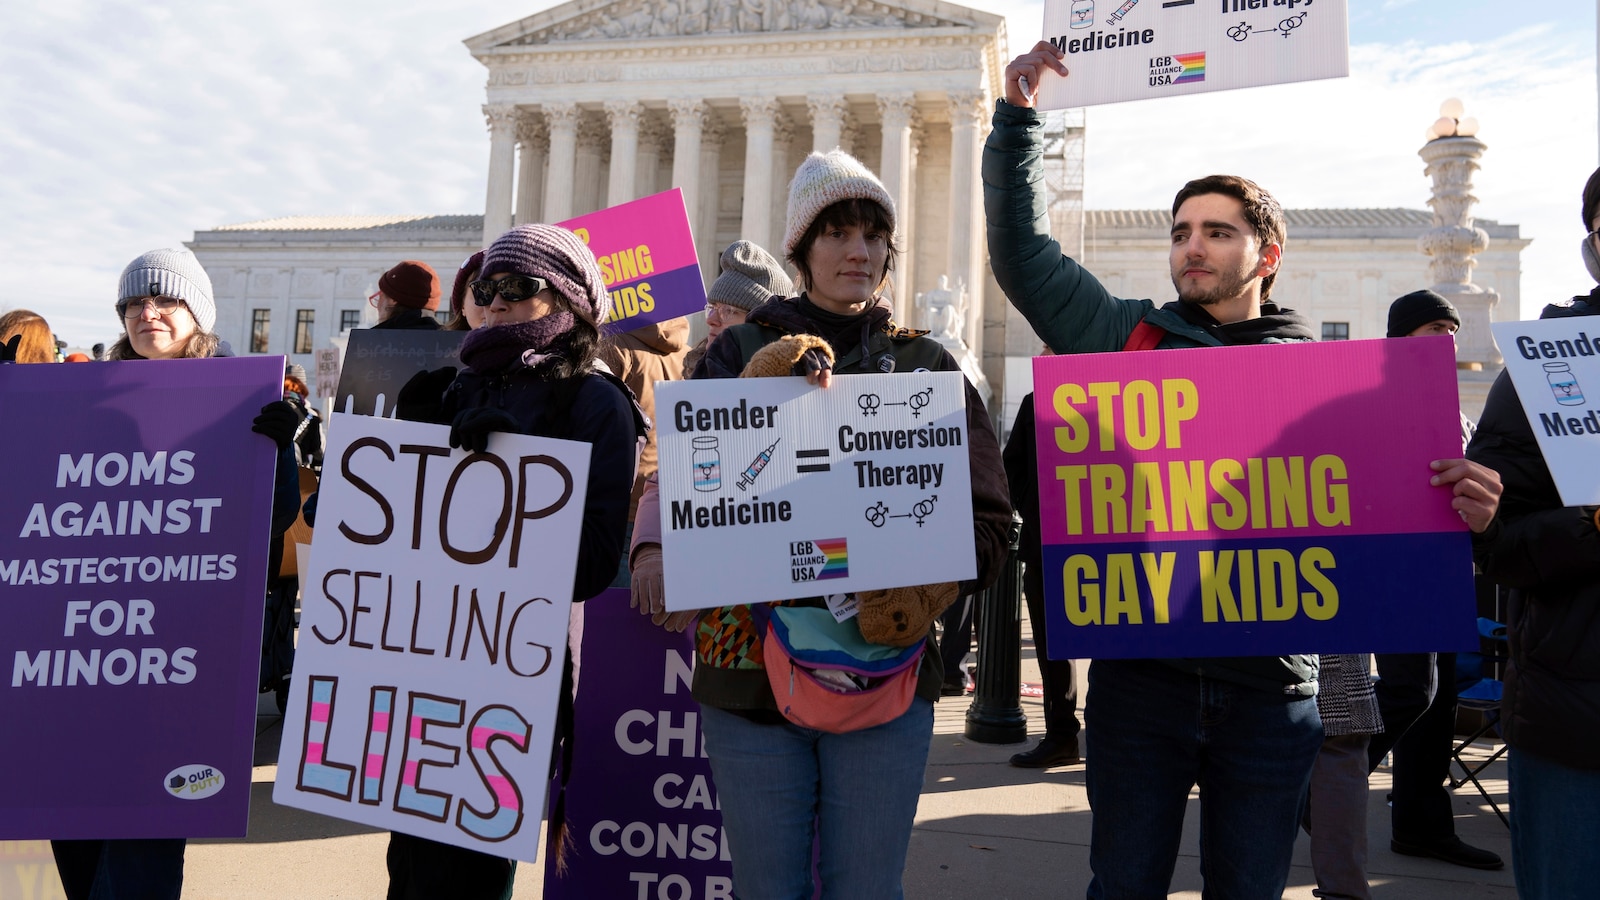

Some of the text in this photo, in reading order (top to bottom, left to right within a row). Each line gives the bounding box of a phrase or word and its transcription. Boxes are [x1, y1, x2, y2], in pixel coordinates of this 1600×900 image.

[1222, 0, 1313, 13] Ther
[1050, 28, 1154, 54] Medicine
[1150, 56, 1171, 68] LGB
[1150, 66, 1183, 75] ALLIANCE
[1149, 75, 1172, 86] USA
[597, 245, 654, 286] SING
[1516, 332, 1600, 360] Gend
[674, 399, 779, 432] Gender
[1052, 378, 1199, 453] STOP
[838, 422, 961, 453] Conversion
[56, 450, 195, 487] MOMS
[853, 460, 944, 490] Therapy
[338, 436, 573, 568] STOP
[1055, 454, 1352, 535] TRANSING
[19, 498, 222, 538] AGAINST
[671, 496, 792, 530] Medicine
[791, 541, 813, 556] LGB
[792, 555, 825, 566] ALLIANCE
[0, 554, 237, 585] MASTECTOMIES
[792, 566, 816, 581] USA
[1062, 546, 1340, 626] GAY KIDS
[64, 599, 155, 636] FOR
[311, 569, 553, 677] SELLING
[12, 647, 198, 687] MINORS
[664, 649, 696, 694] N
[296, 675, 533, 842] LIES
[189, 768, 214, 783] OUR
[190, 774, 221, 793] DUTY
[653, 773, 721, 810] CA
[589, 820, 732, 861] CONS
[629, 872, 692, 900] TO
